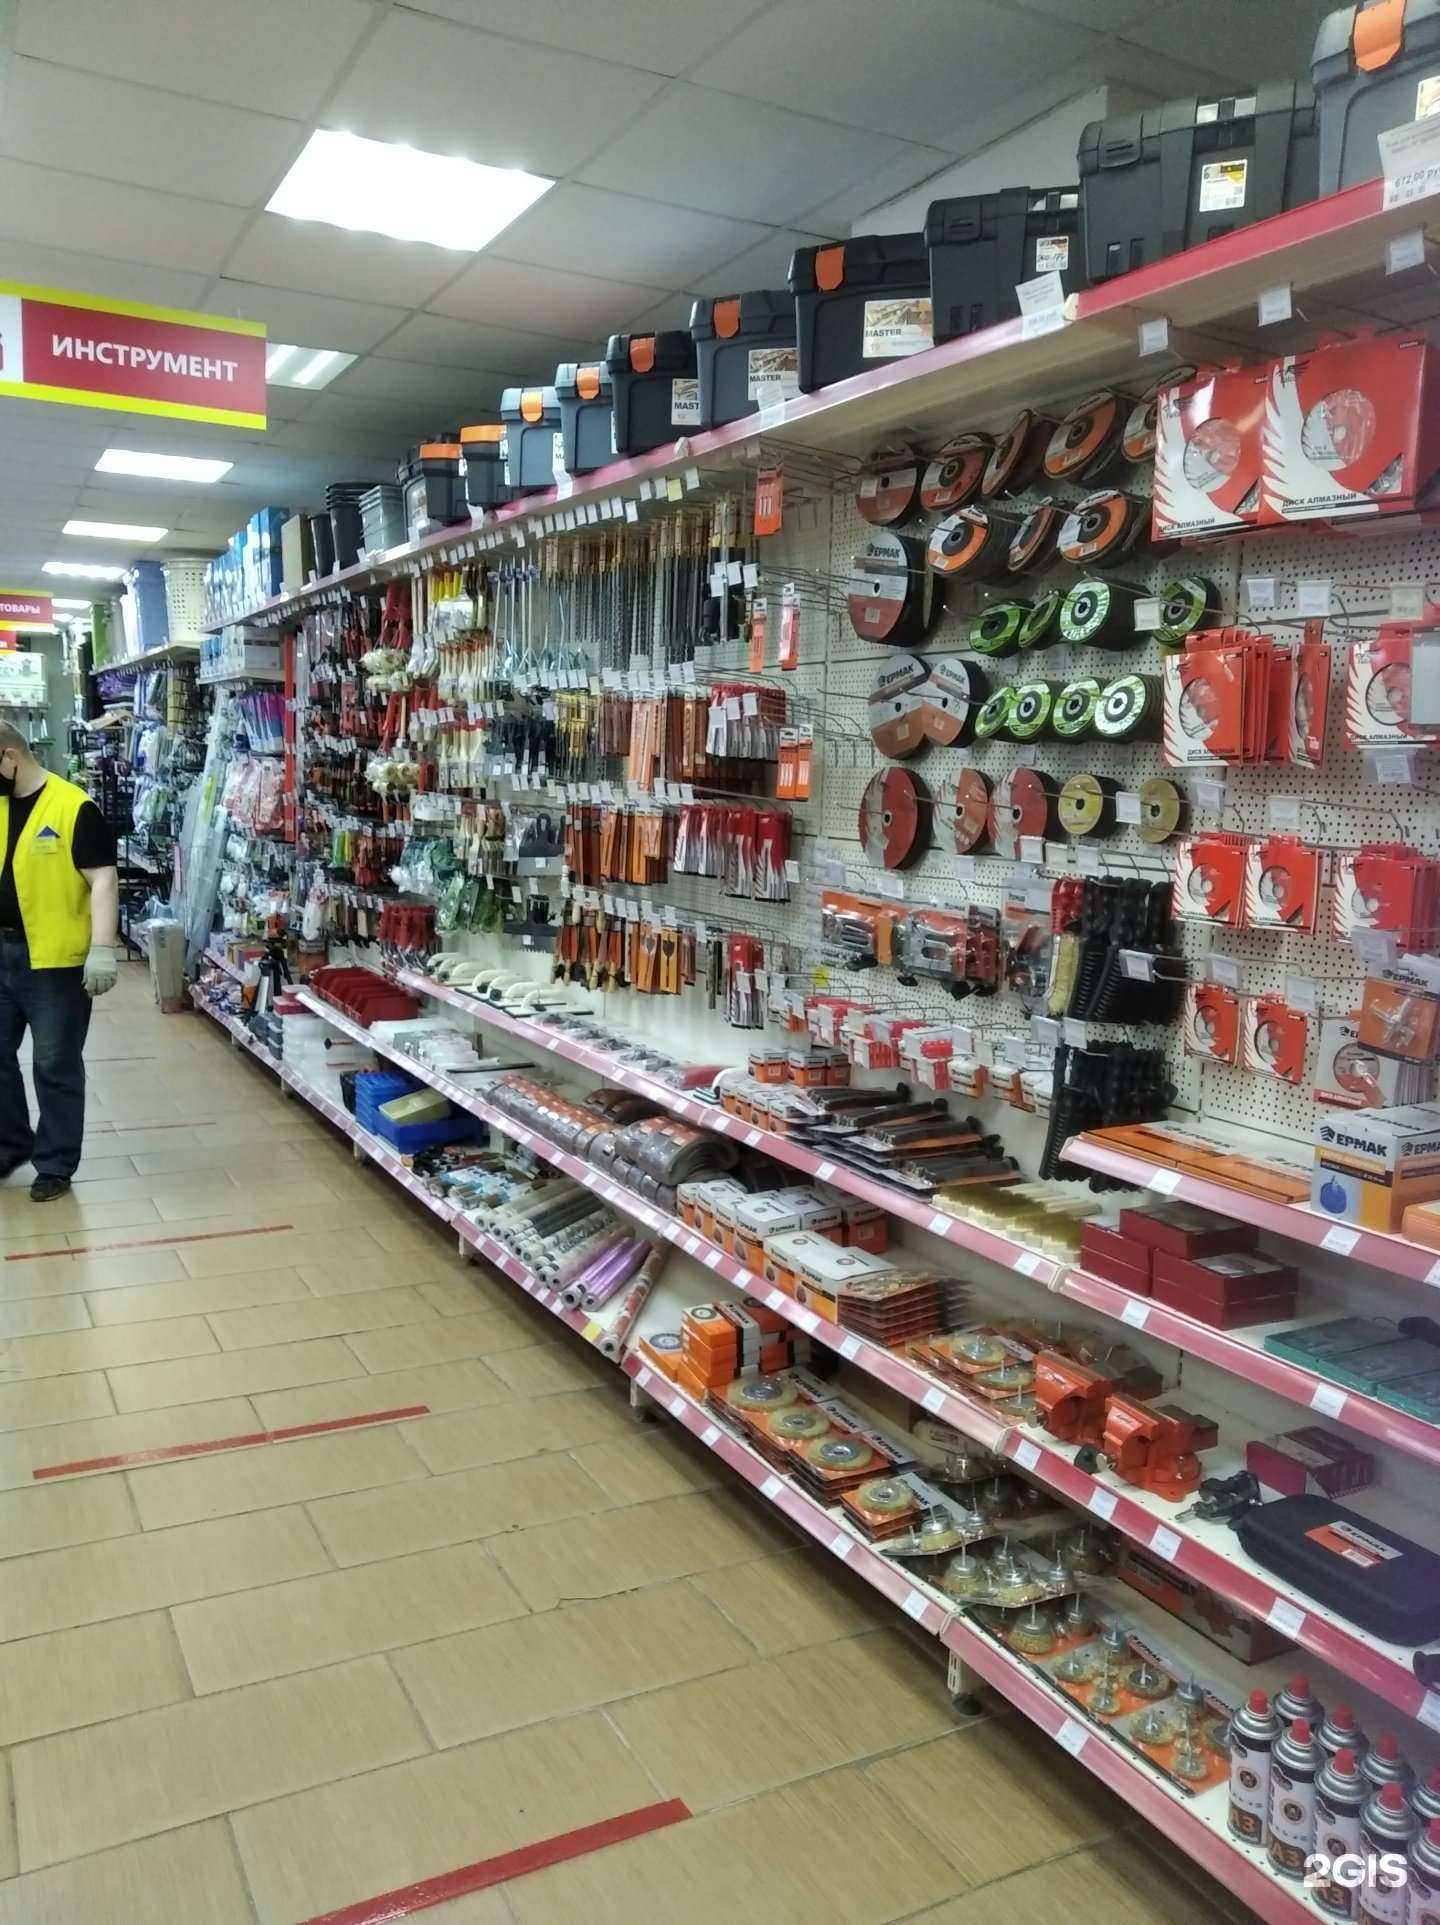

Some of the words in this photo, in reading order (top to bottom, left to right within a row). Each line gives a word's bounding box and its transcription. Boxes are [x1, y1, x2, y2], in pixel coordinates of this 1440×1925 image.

[865, 328, 902, 338] MASTER
[51, 333, 238, 382] ИНСТРУМЕНТ
[749, 374, 782, 383] MASTER
[674, 401, 699, 410] MAST
[1307, 493, 1357, 505] АЛМАЗНЫЙ
[1336, 1133, 1388, 1157] ЕРМАК
